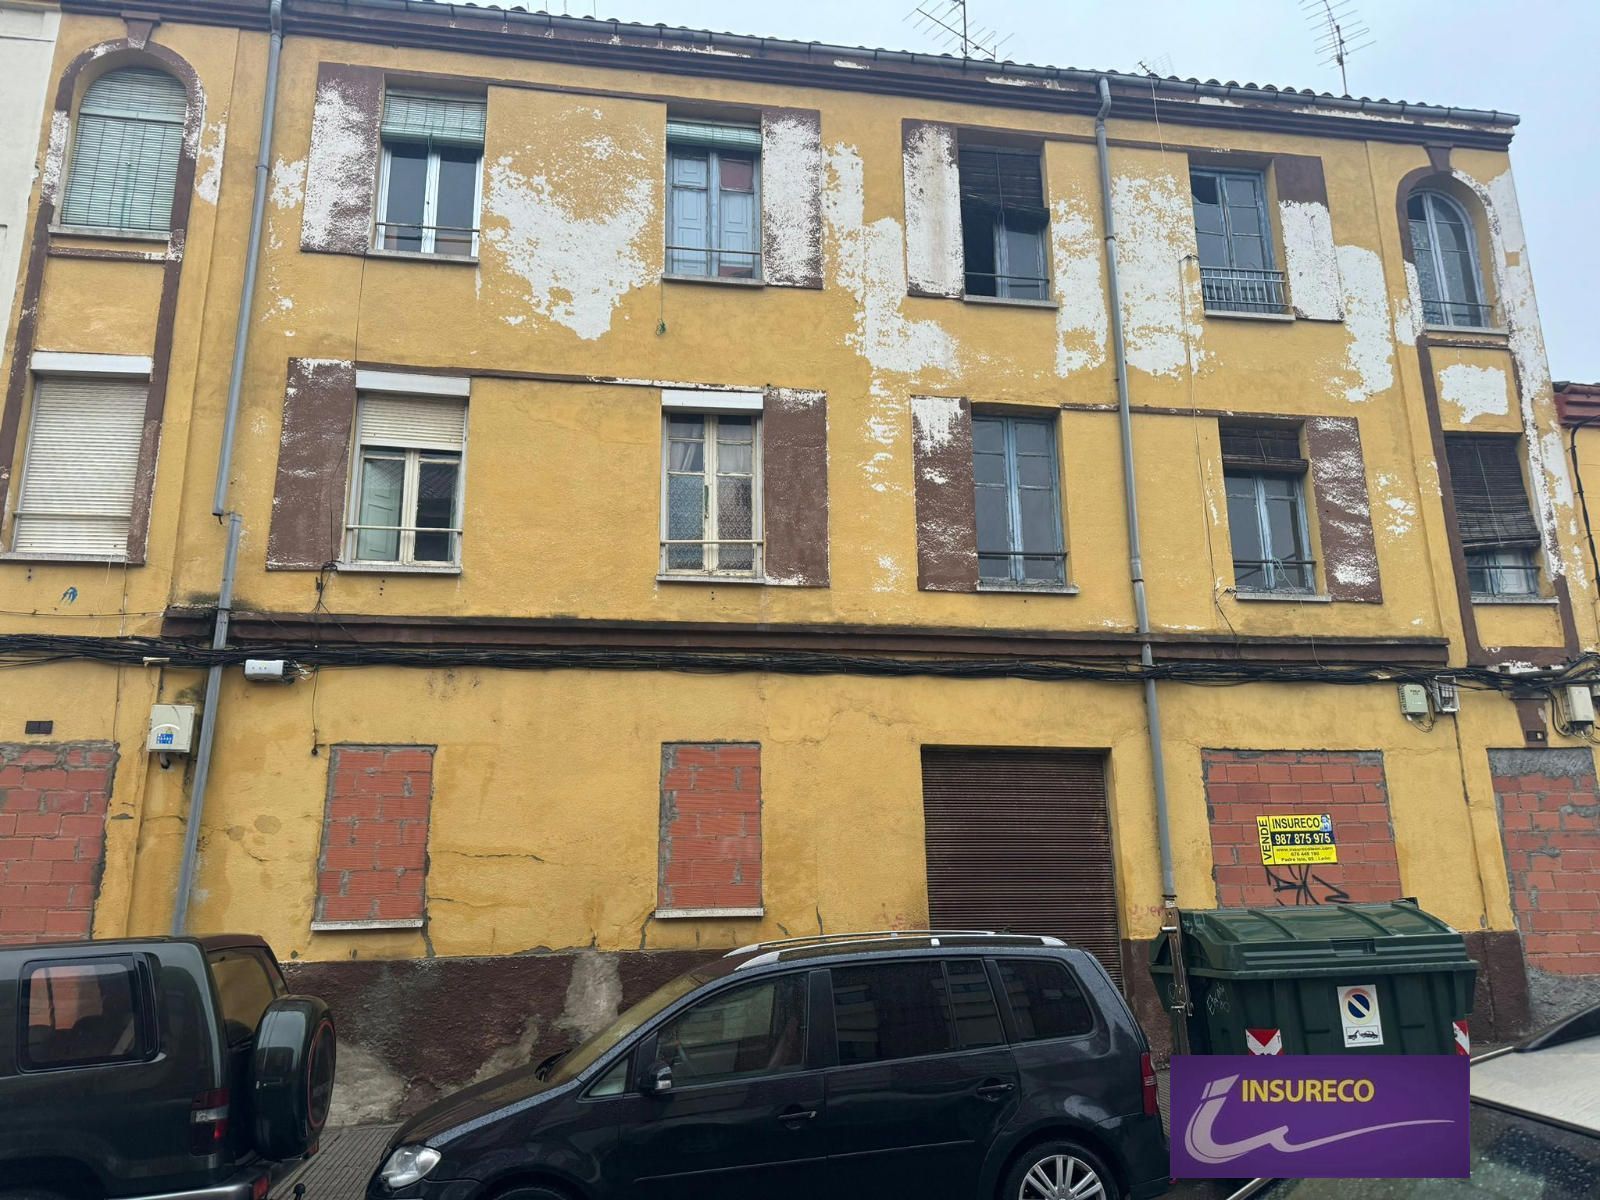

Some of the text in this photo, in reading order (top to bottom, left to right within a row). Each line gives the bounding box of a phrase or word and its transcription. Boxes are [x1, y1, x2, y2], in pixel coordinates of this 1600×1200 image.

[1272, 817, 1321, 829] INSURECO
[1258, 819, 1273, 861] VENDE
[1275, 832, 1331, 845] 987 875 975
